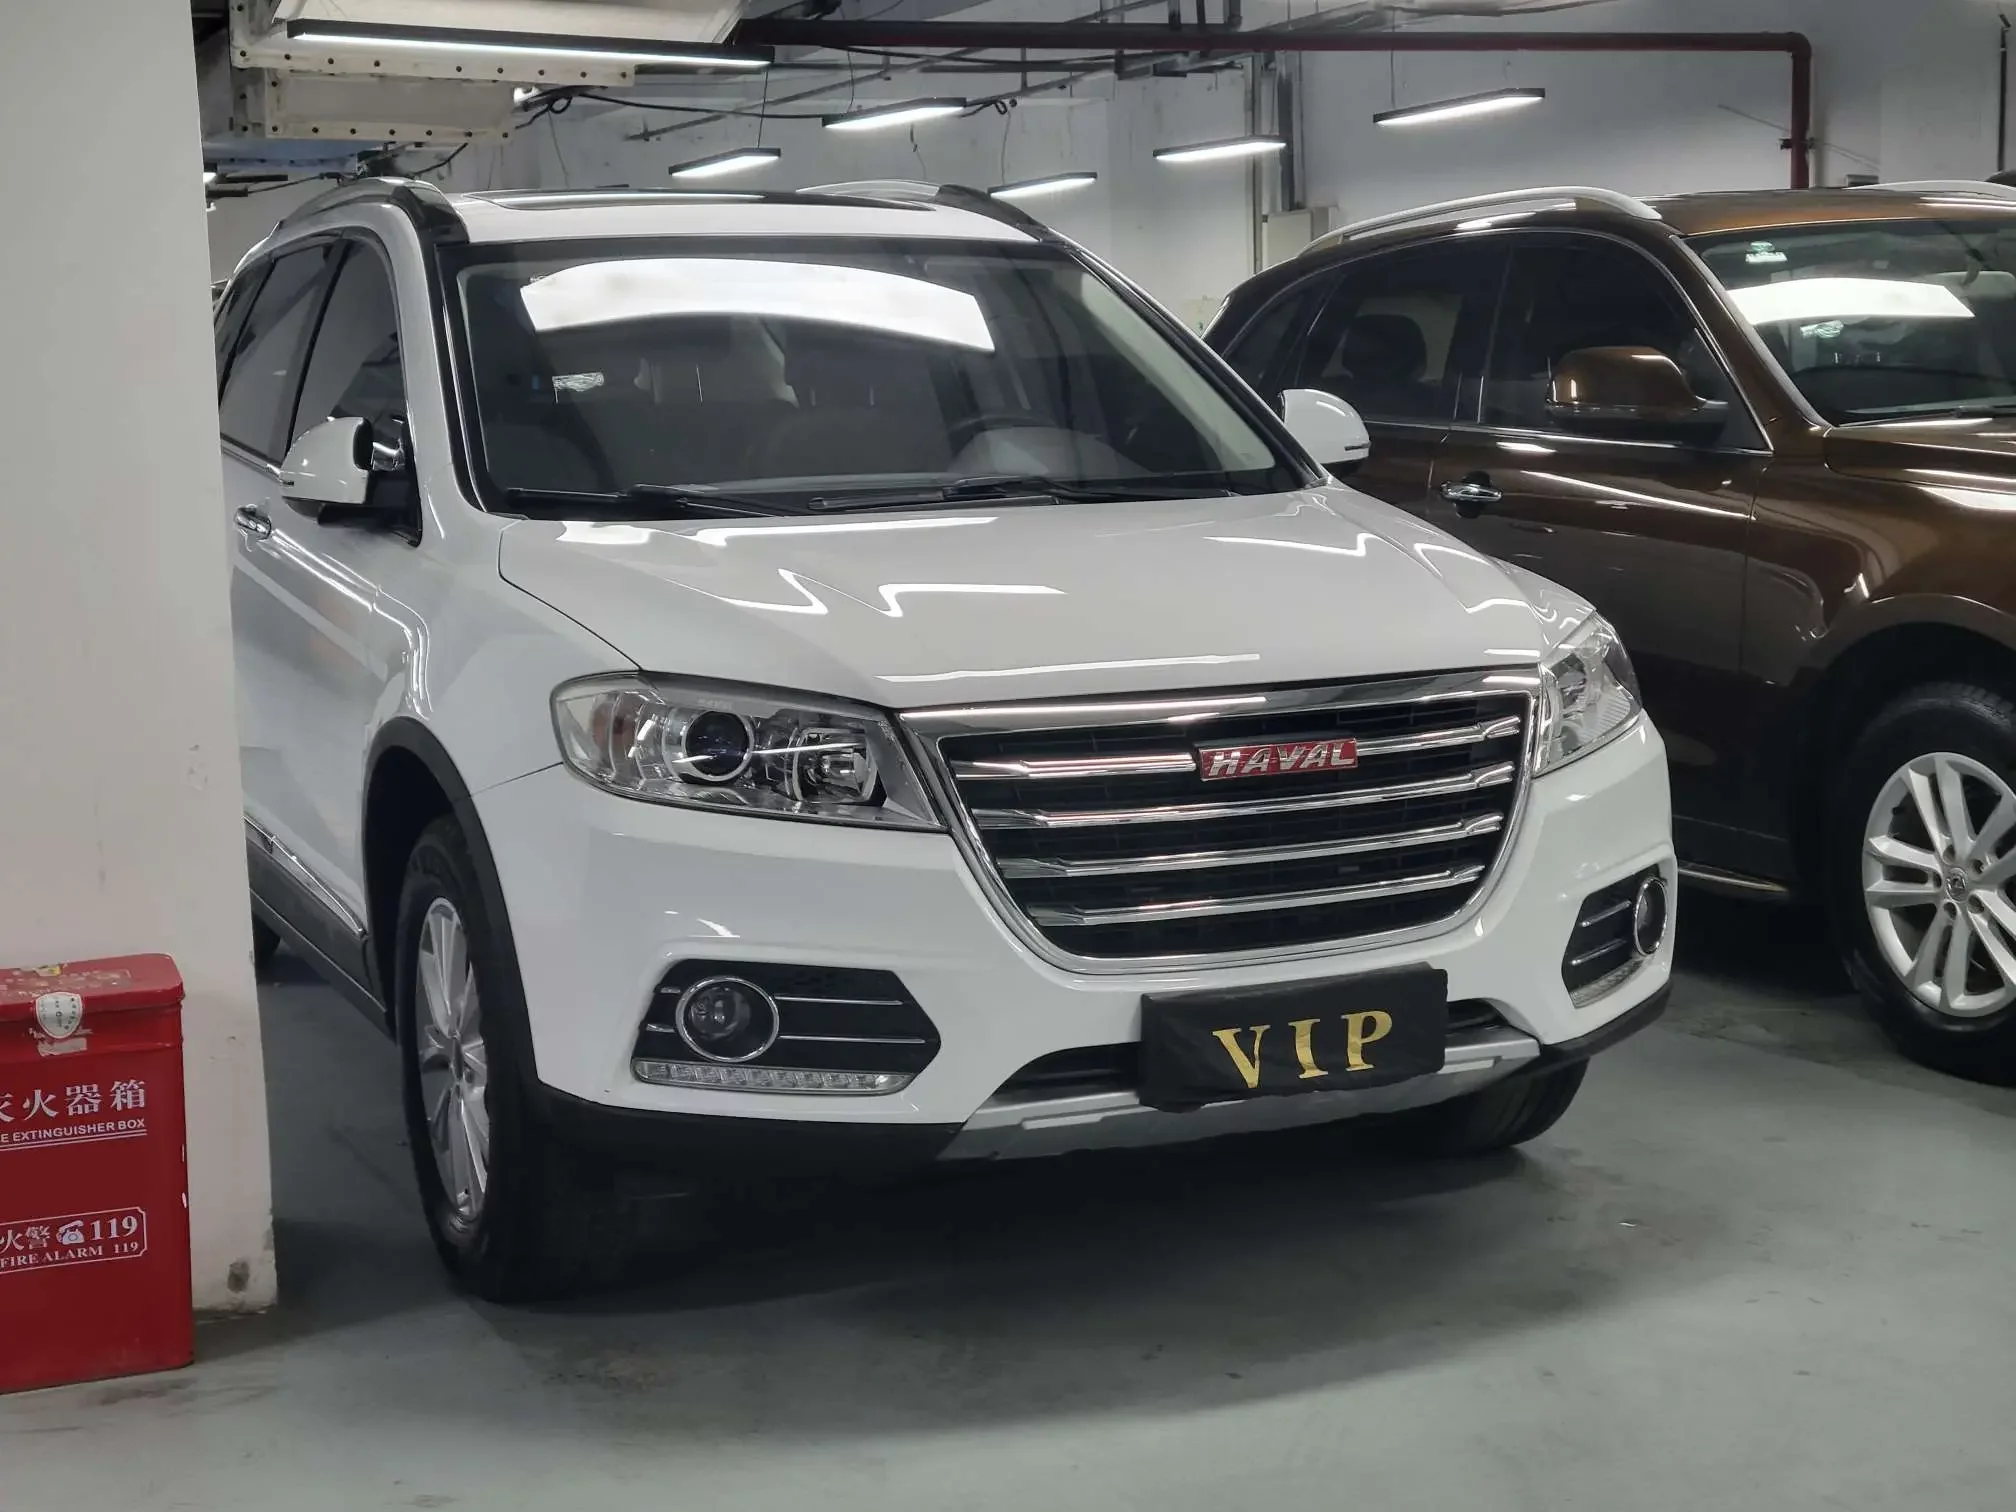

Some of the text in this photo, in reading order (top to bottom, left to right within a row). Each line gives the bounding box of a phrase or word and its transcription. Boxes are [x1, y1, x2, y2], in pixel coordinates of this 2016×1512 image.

[1207, 743, 1355, 777] HAVAL
[1212, 1010, 1392, 1089] VIP
[12, 1121, 115, 1142] EXTINGUISHER
[118, 1118, 146, 1131] BOX
[0, 1215, 138, 1254] 火警 119
[0, 1241, 139, 1268] FIRE ALARM 119
